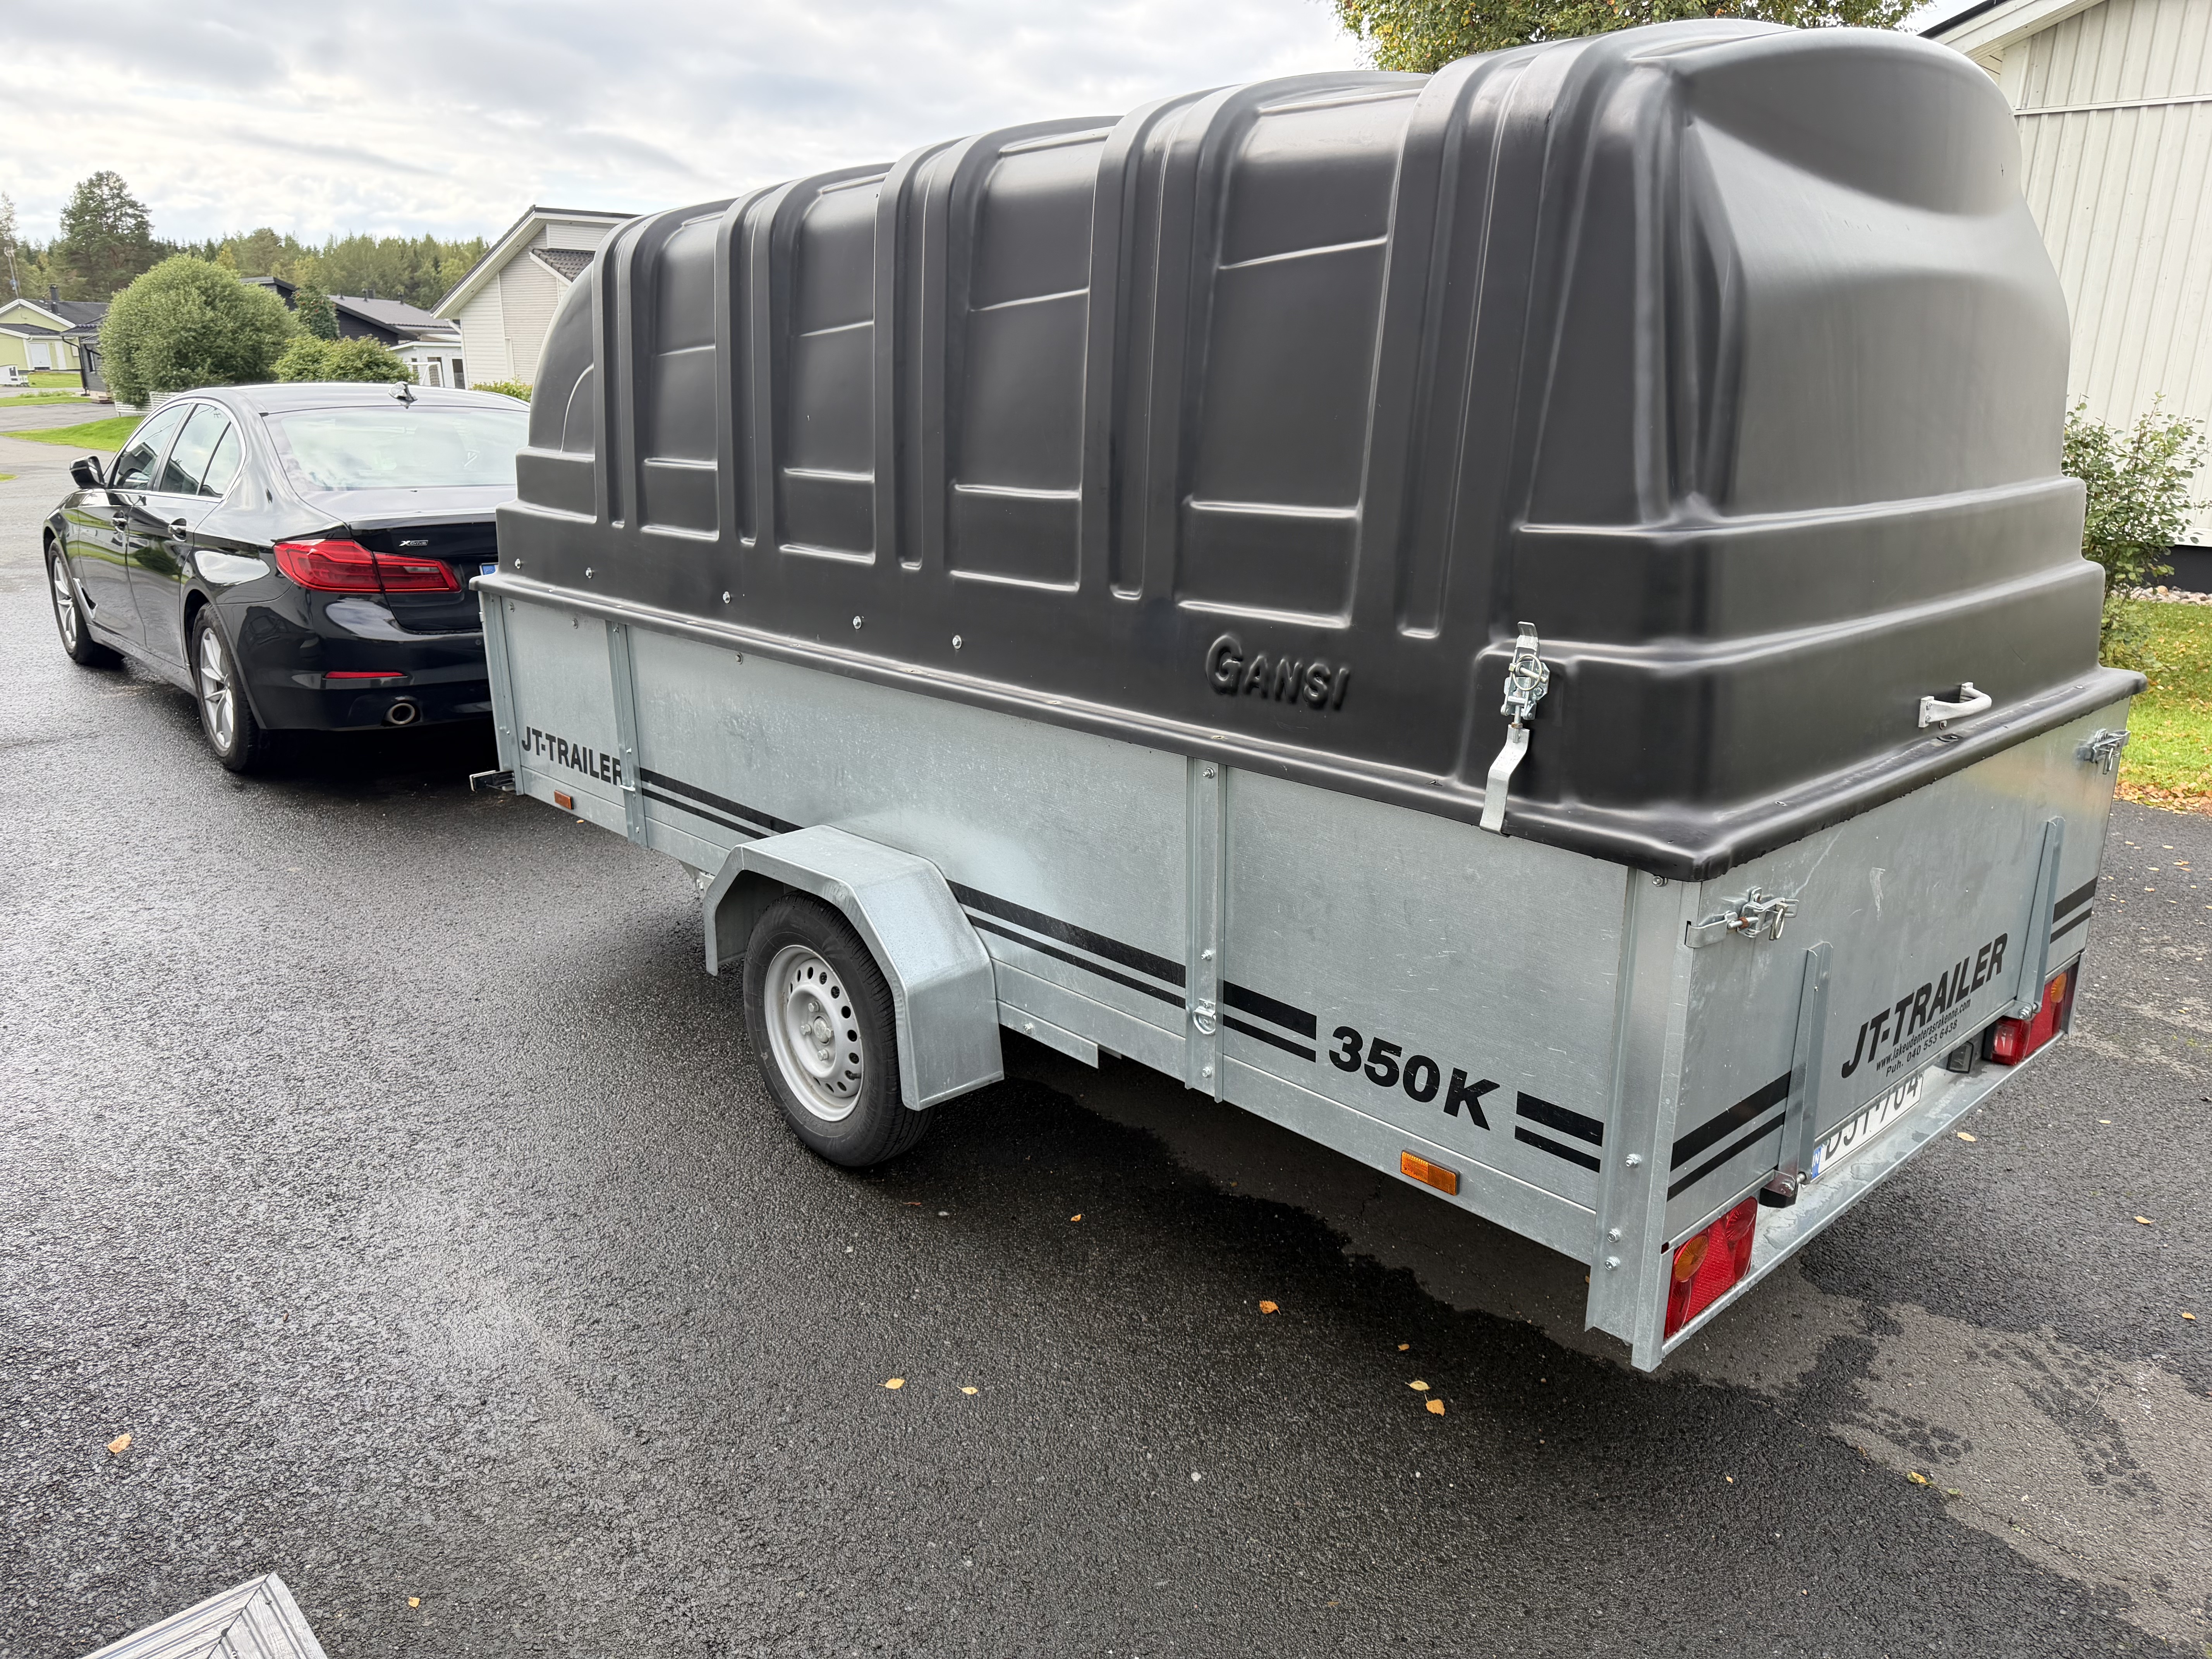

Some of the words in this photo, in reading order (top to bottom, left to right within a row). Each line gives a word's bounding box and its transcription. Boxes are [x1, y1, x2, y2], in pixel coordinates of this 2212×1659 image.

[1206, 634, 1350, 711] GANSI
[522, 726, 622, 785] JT-TRAILER
[1841, 933, 2008, 1079] JT-TRAILER
[1876, 999, 1971, 1072] www.lakeudenterasrakenne.com
[1329, 1026, 1500, 1130] 350K
[1886, 1060, 1903, 1077] Puh.
[1907, 1044, 1921, 1062] 040
[1923, 1033, 1937, 1050] 553
[1940, 1019, 1958, 1039] 6438
